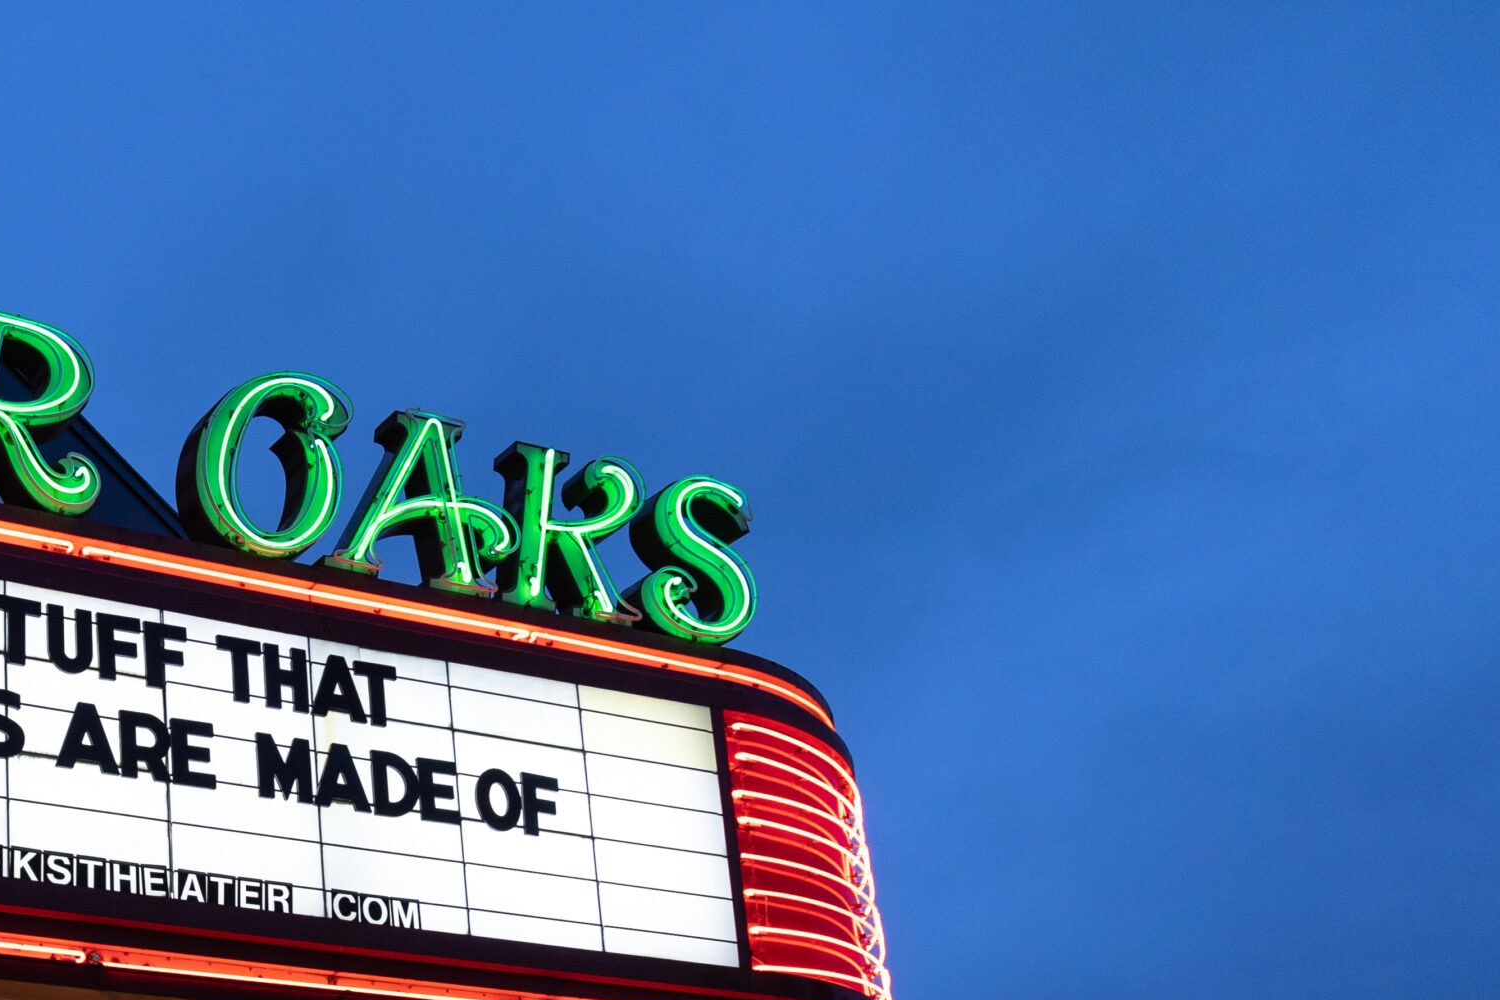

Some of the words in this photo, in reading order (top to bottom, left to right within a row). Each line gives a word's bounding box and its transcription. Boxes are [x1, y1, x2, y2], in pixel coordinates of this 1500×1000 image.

[176, 371, 757, 644] OAKS
[216, 635, 396, 727] THAT
[56, 703, 217, 789] ARE
[256, 733, 462, 826] MADE
[474, 769, 558, 836] OF
[332, 892, 420, 930] COM
